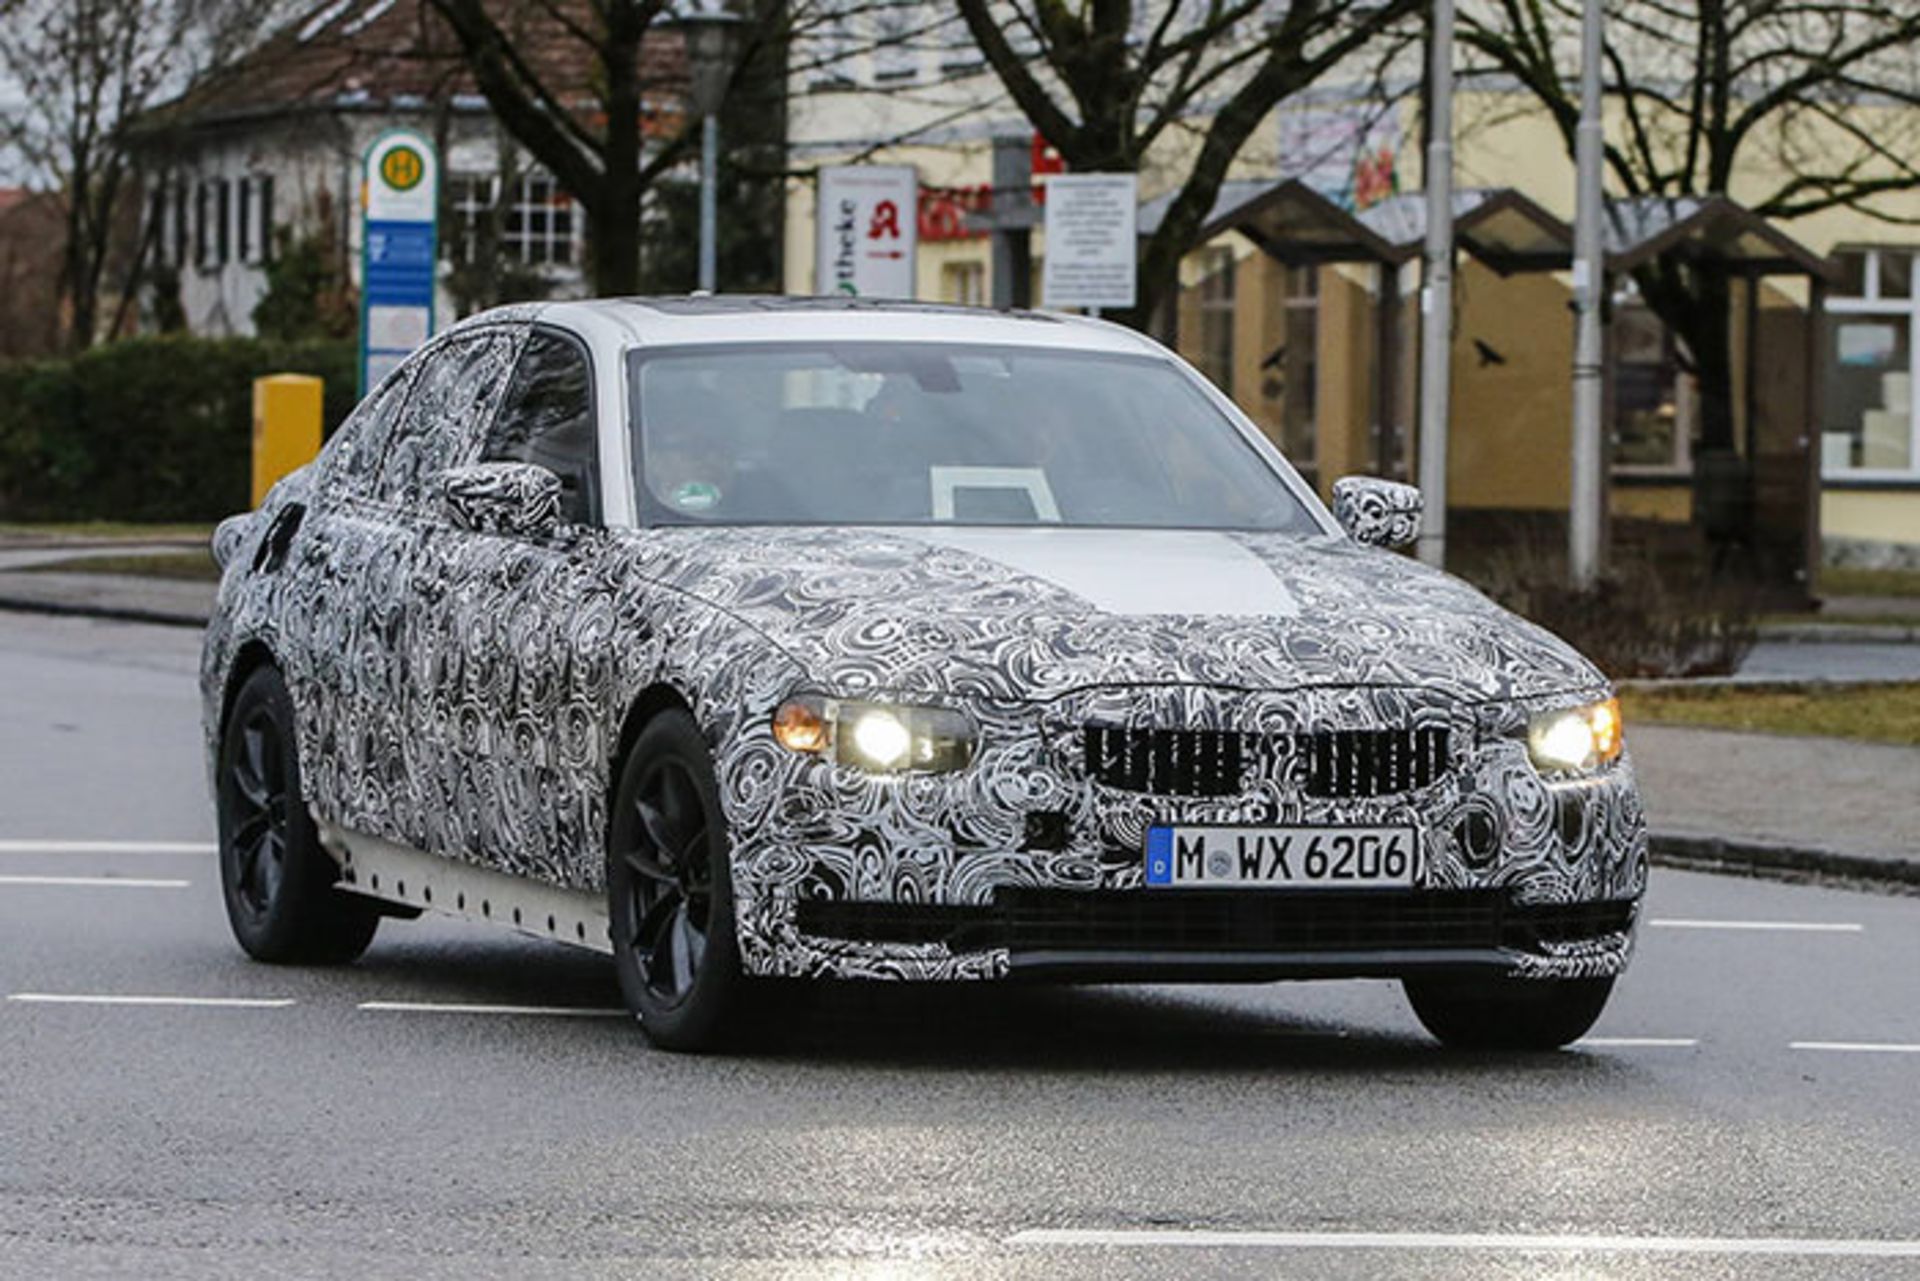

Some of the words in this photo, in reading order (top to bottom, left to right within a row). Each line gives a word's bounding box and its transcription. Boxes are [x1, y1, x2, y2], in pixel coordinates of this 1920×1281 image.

[1154, 860, 1167, 876] D
[1177, 836, 1204, 879] M
[1238, 836, 1292, 879] WX
[1305, 835, 1407, 878] 6206
